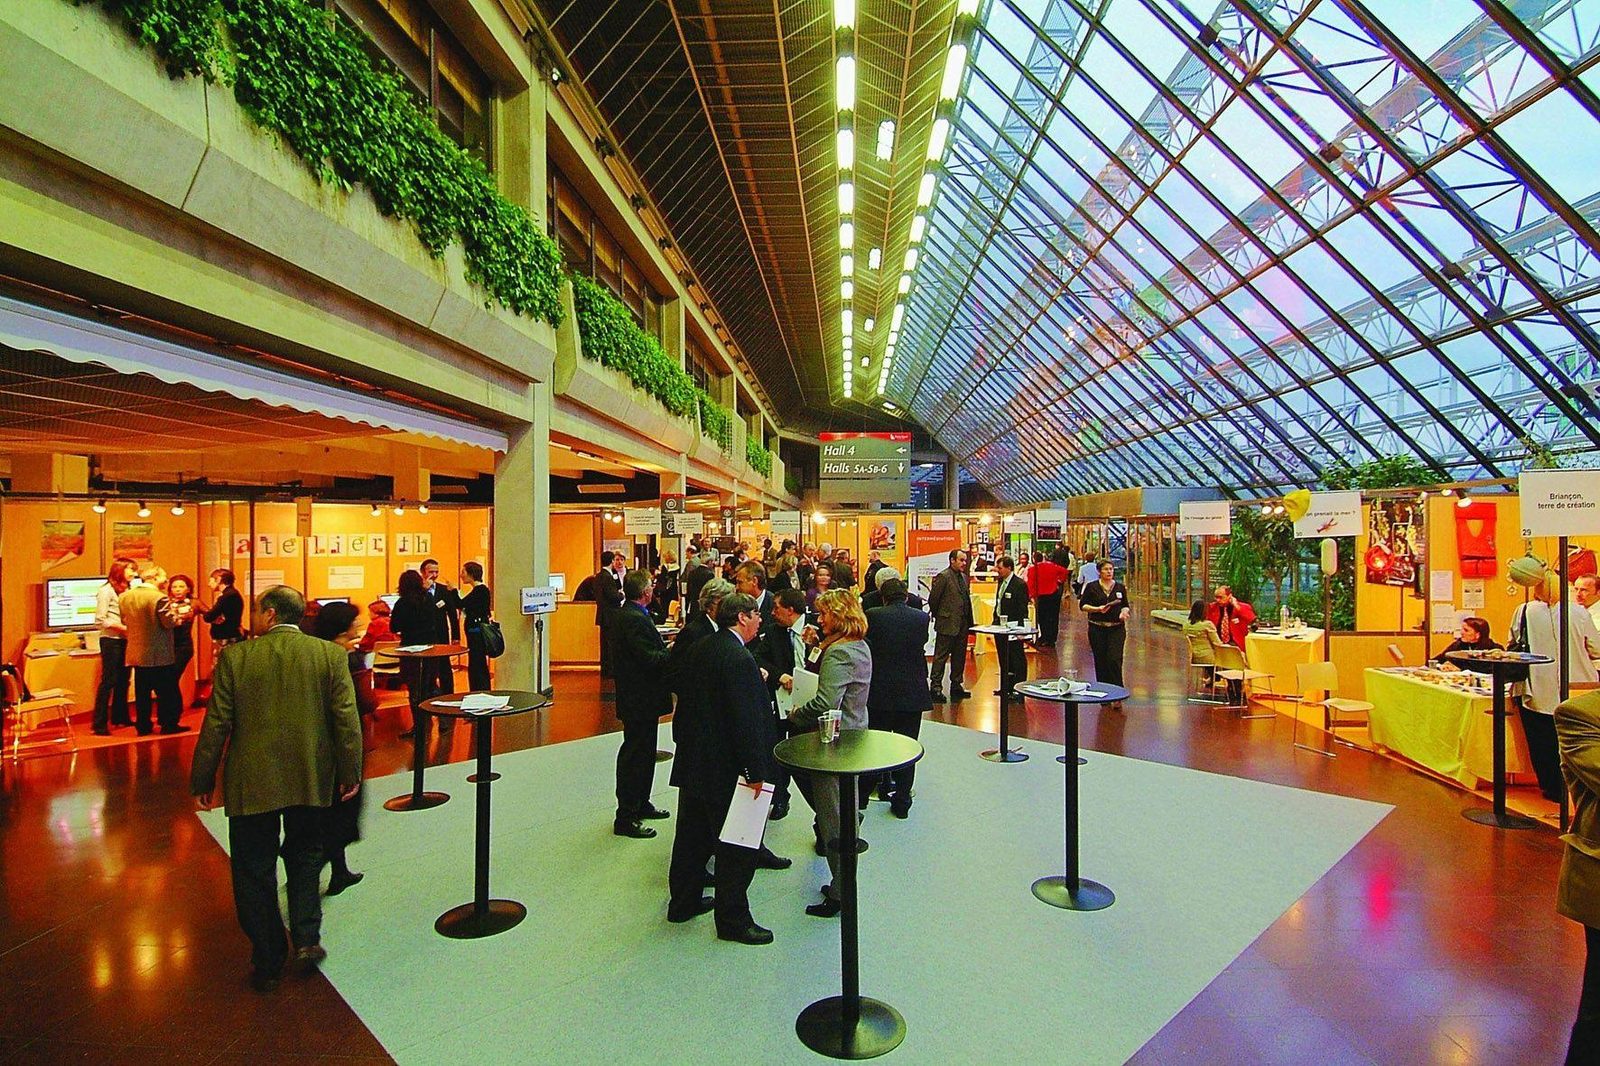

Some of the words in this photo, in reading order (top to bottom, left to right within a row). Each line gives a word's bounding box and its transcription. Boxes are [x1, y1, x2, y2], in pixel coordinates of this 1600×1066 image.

[823, 445, 846, 456] Hall
[847, 445, 856, 456] 4
[823, 462, 850, 474] Halls
[1549, 493, 1584, 501] Briançon,
[1567, 501, 1596, 509] création
[1522, 528, 1532, 536] 29
